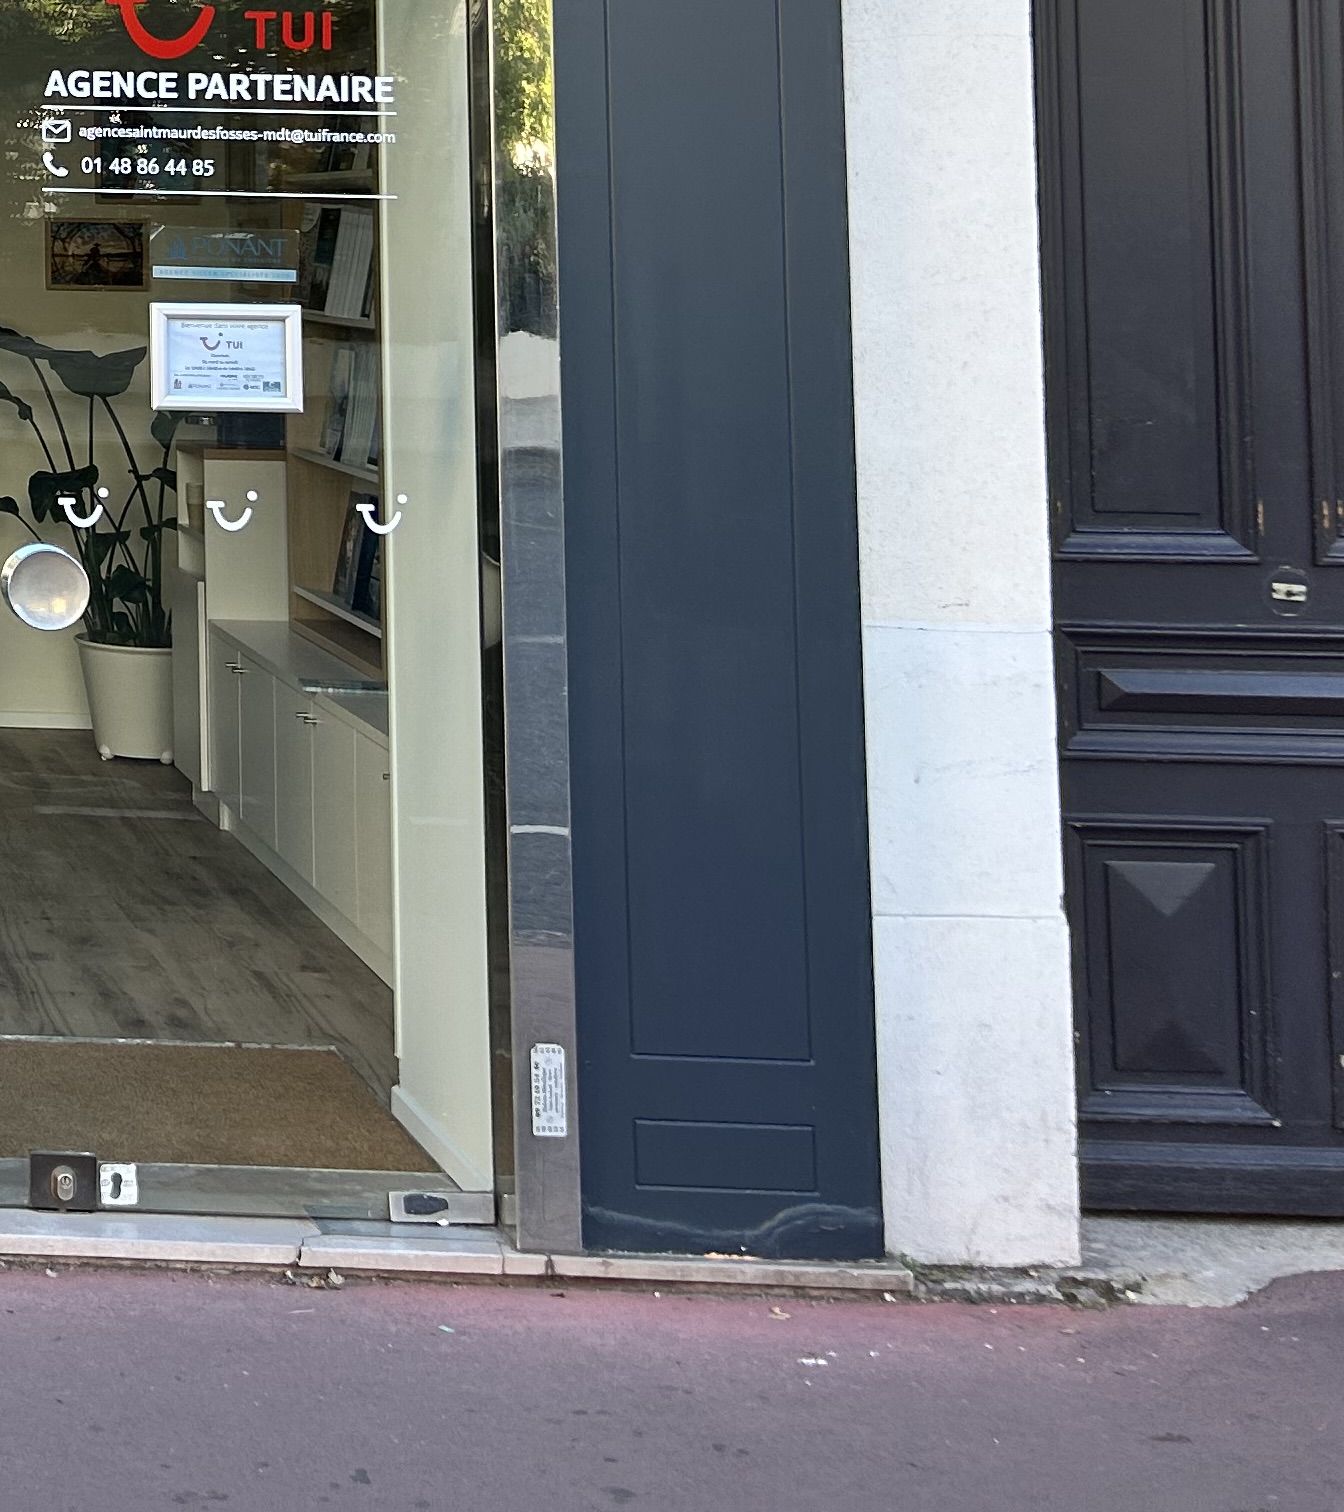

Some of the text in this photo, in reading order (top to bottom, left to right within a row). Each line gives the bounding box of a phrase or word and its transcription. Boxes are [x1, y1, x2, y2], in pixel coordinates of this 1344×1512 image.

[244, 11, 332, 50] TUI
[43, 69, 395, 103] AGENCE PARTENAIRE
[78, 125, 396, 144] agencesaintmaurdesfosses-mdt@tuifrance.com
[81, 157, 215, 177] 01 48 86 44 85
